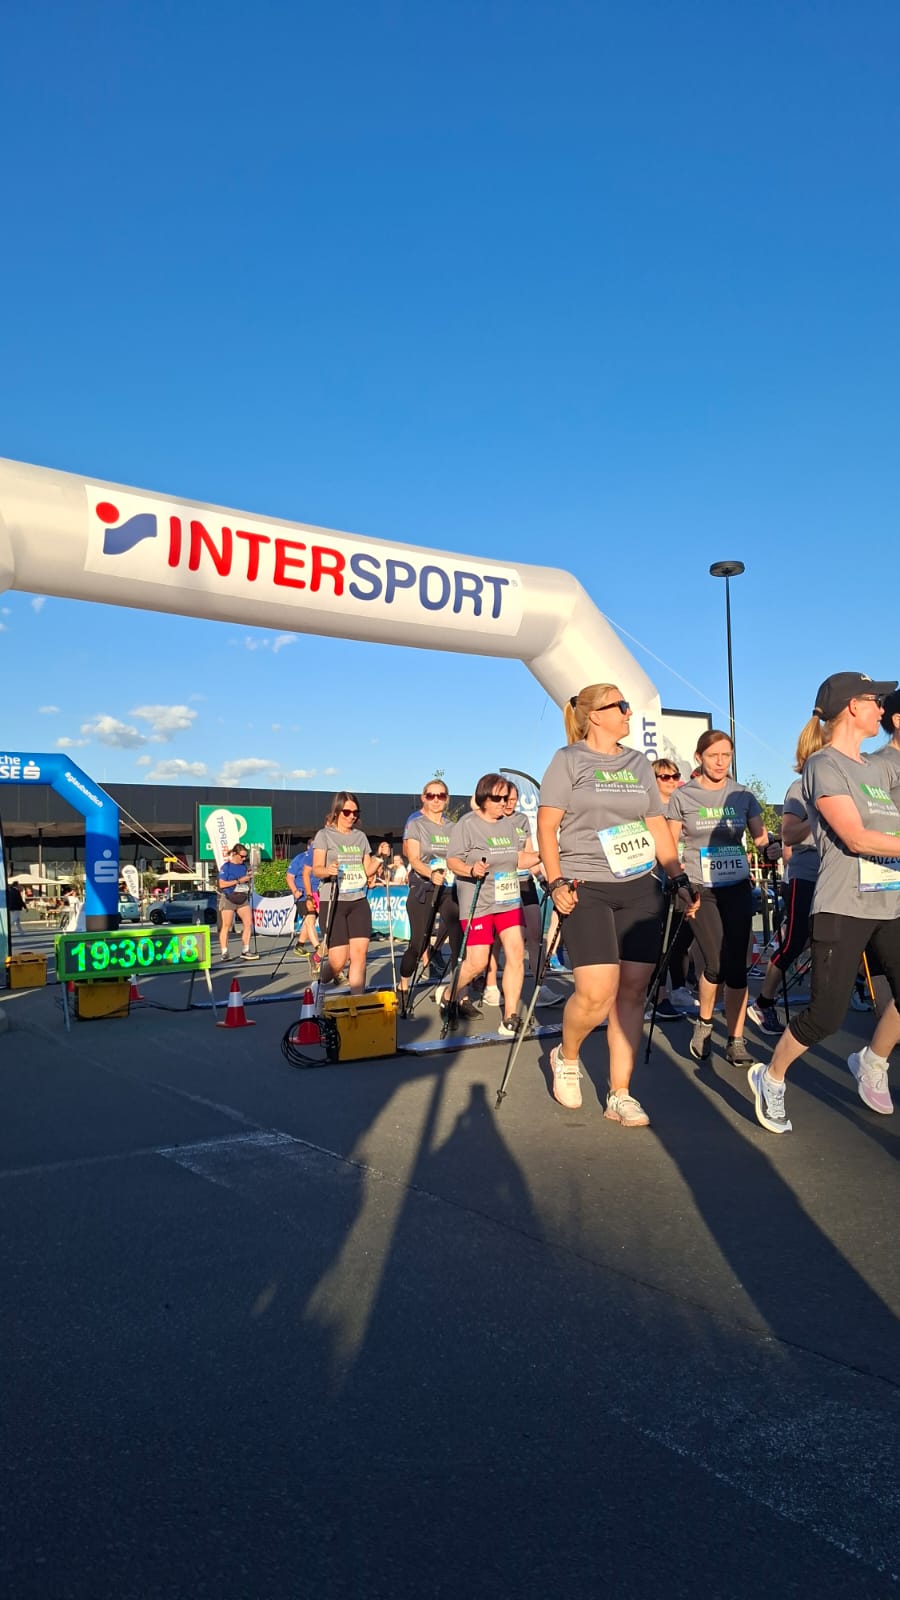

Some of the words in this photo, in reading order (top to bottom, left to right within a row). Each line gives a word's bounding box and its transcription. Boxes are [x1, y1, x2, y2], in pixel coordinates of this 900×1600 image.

[168, 516, 510, 619] INTERSPORT
[642, 717, 658, 761] ORT
[602, 770, 634, 781] Menda
[706, 807, 736, 818] Menda
[614, 837, 649, 855] 5011A
[711, 859, 743, 870] 5011E
[71, 935, 198, 971] 19:30:48
